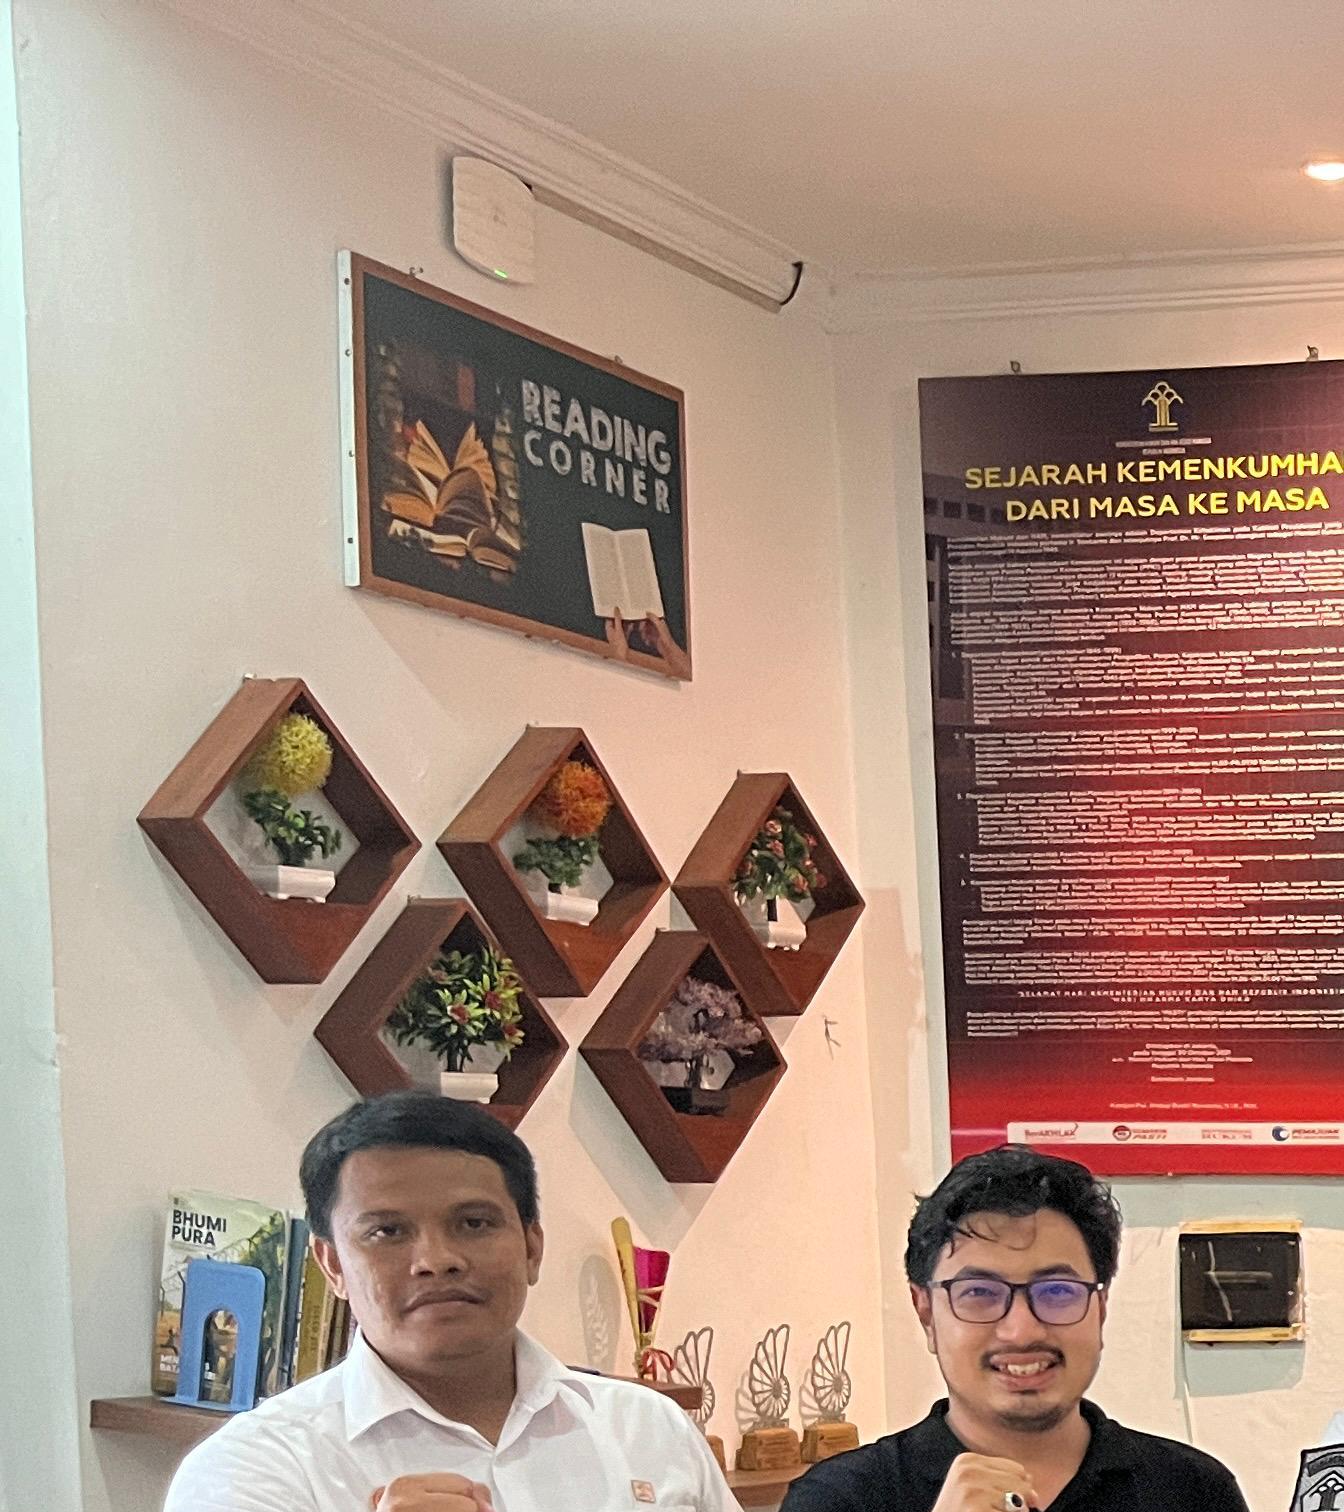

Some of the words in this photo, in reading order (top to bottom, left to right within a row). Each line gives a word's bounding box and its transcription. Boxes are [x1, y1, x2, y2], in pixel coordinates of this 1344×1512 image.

[522, 380, 672, 474] READING
[524, 431, 670, 514] CORNER
[965, 462, 1107, 489] SEJARAH
[1006, 497, 1081, 521] DARI
[1089, 494, 1179, 518] MASA
[1188, 492, 1228, 515] KE
[1237, 488, 1329, 513] MASA
[172, 1226, 216, 1246] PURA
[173, 1209, 226, 1233] BHUMI
